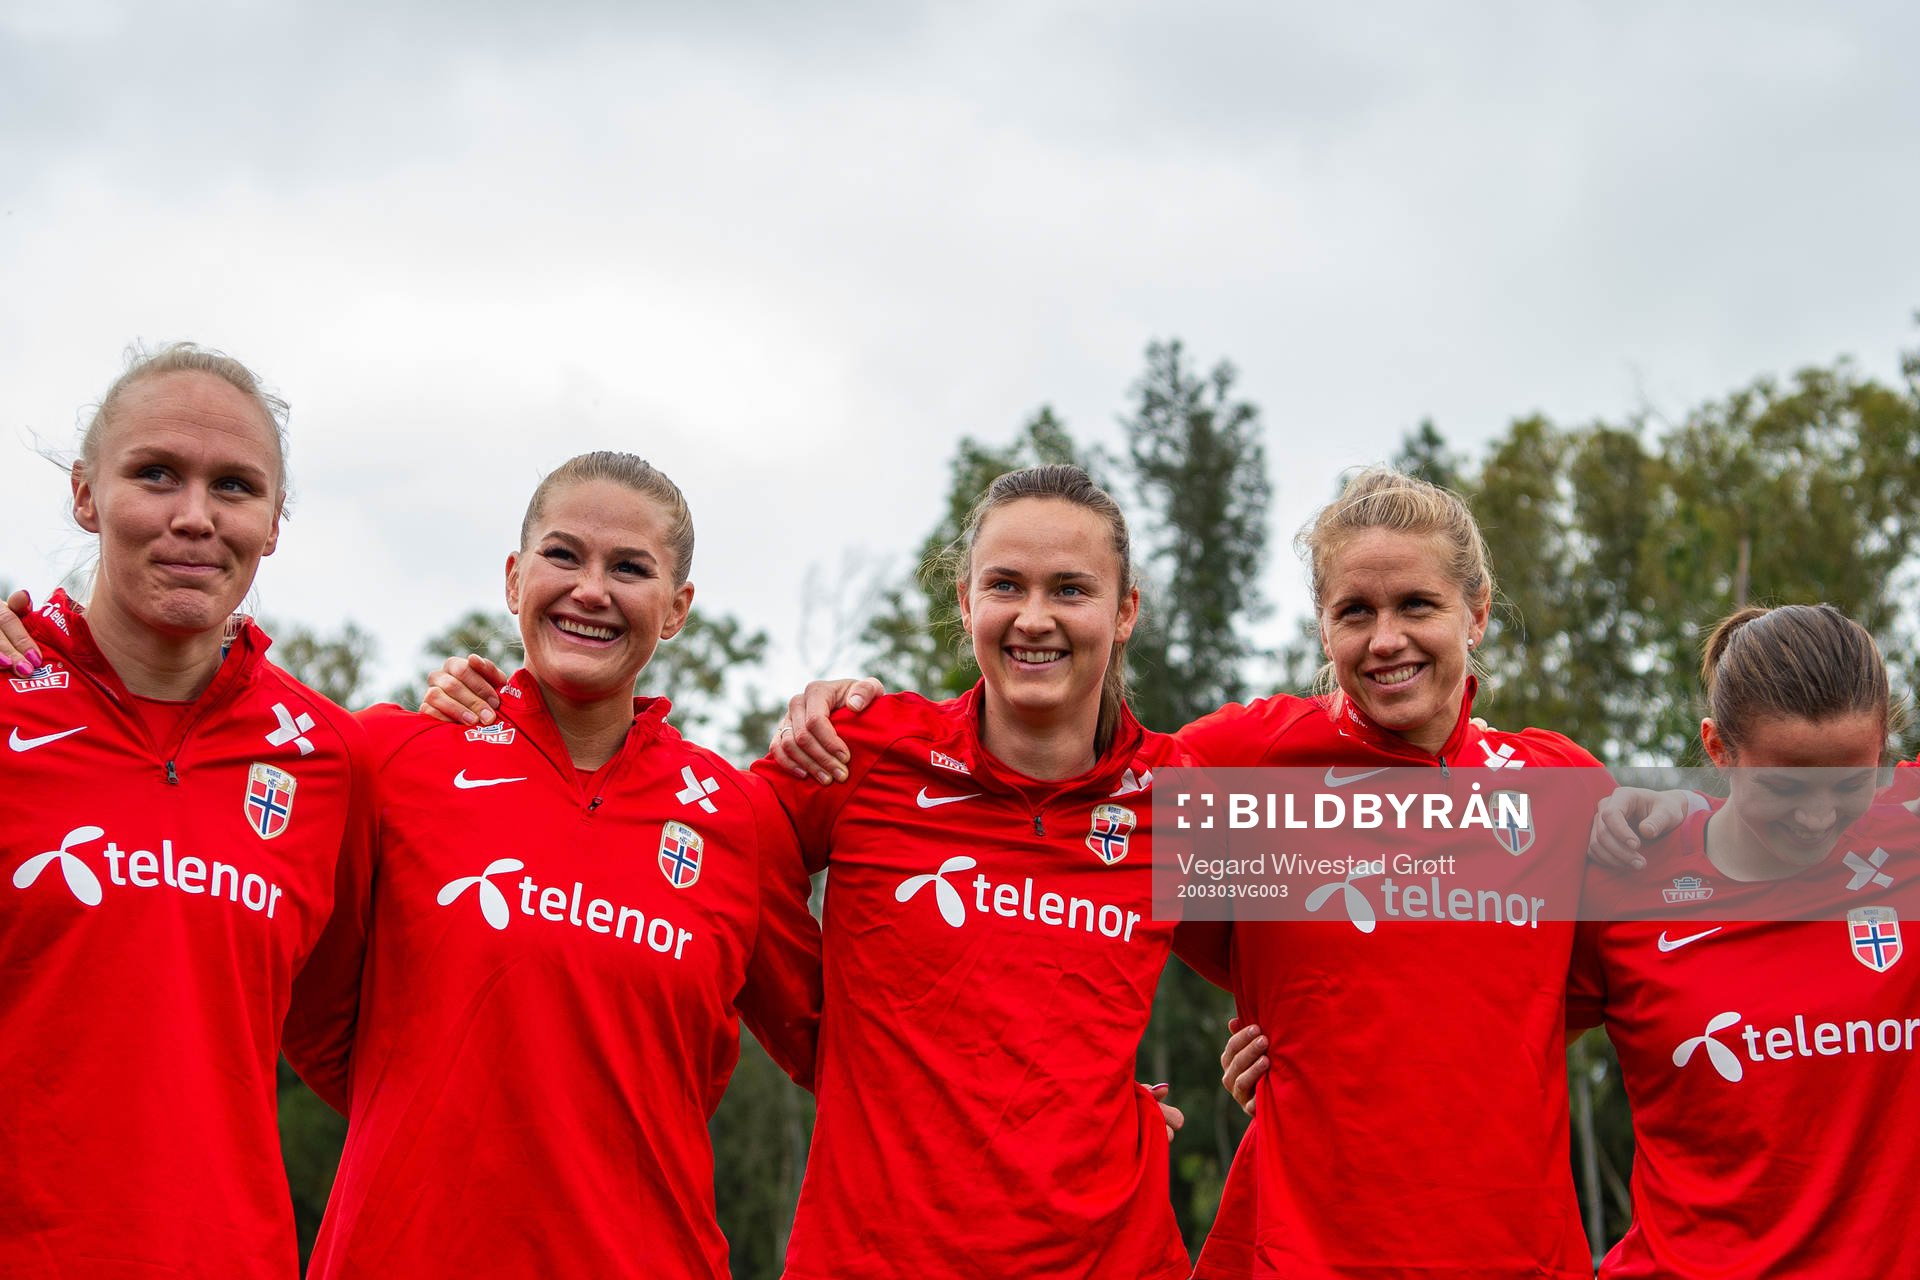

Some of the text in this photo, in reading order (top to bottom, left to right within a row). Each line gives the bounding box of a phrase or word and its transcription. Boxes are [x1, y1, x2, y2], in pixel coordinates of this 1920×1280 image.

[17, 675, 63, 689] TINE
[471, 730, 509, 742] TINE
[103, 839, 282, 919] telenor
[1380, 876, 1545, 929] telenor
[1668, 890, 1706, 901] TINE
[518, 876, 693, 960] telenor
[972, 873, 1141, 943] telenor
[1741, 1014, 1920, 1062] telenor
